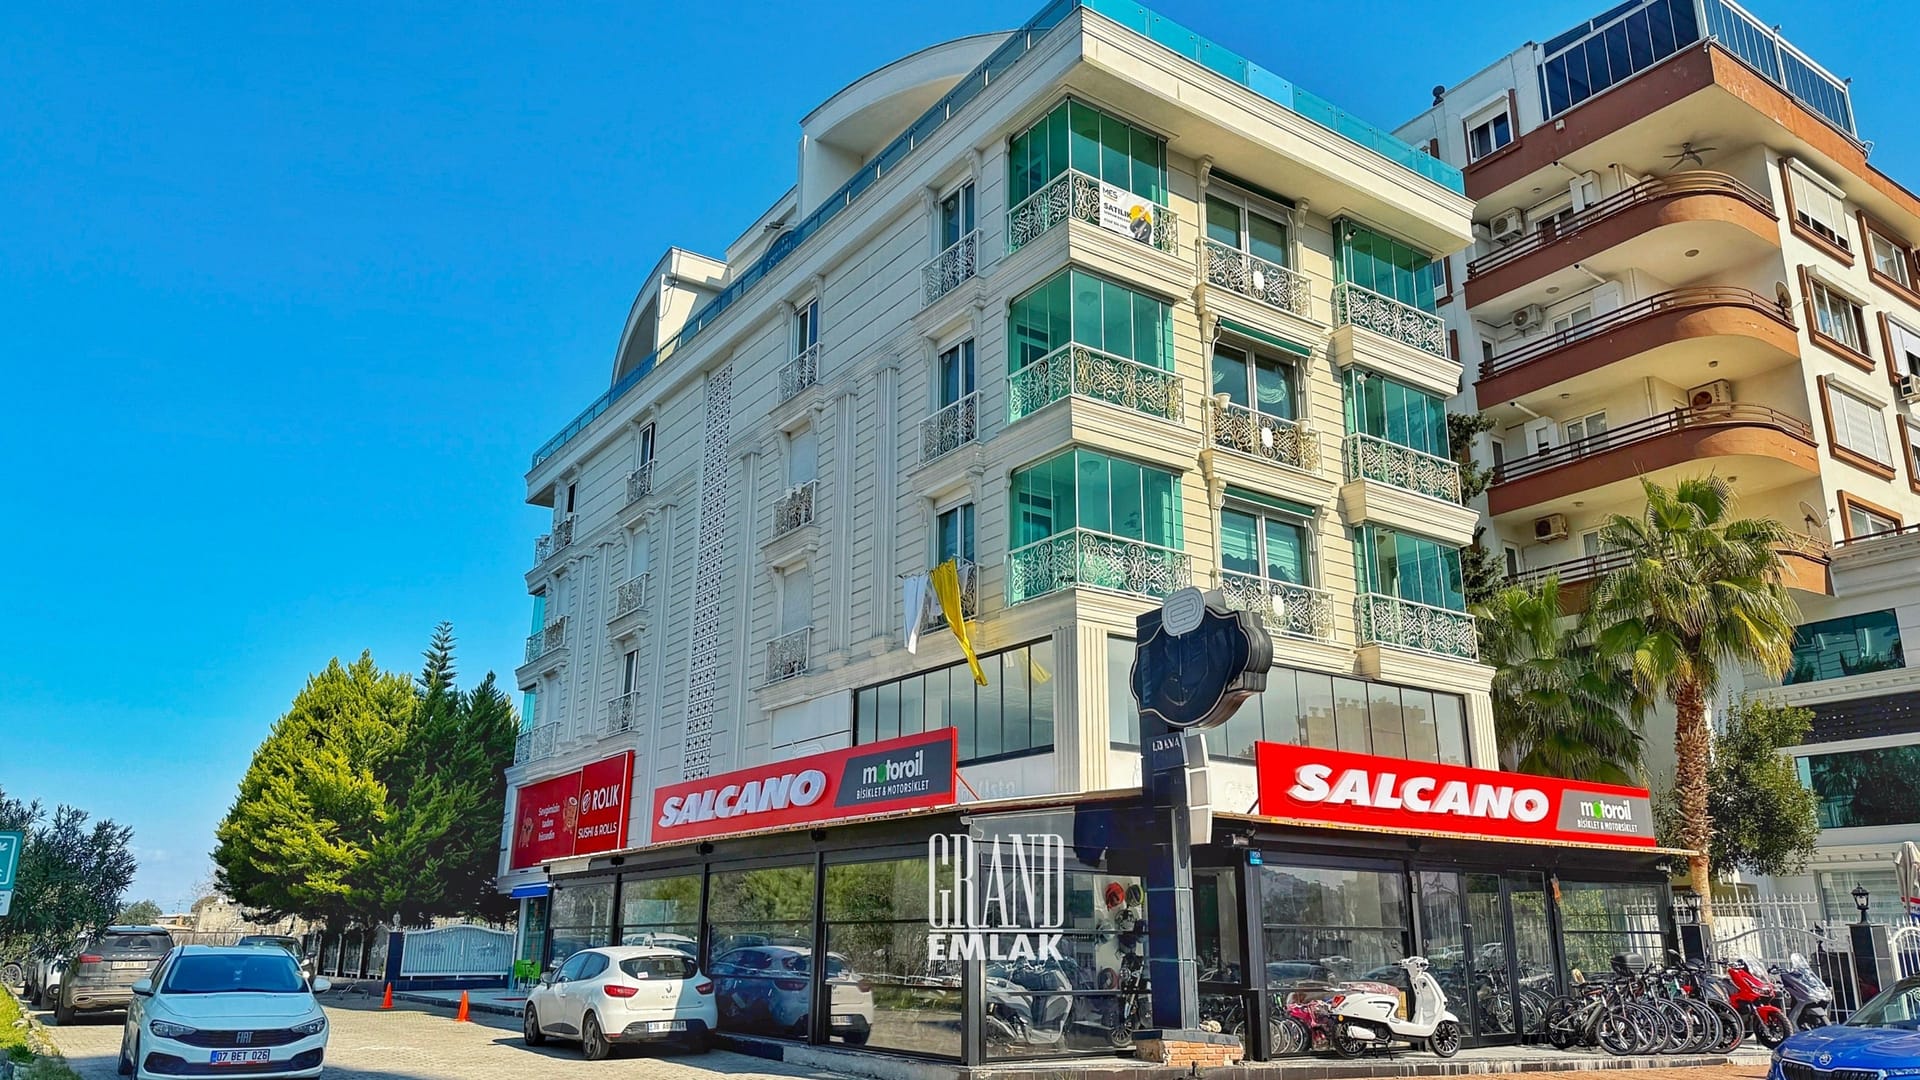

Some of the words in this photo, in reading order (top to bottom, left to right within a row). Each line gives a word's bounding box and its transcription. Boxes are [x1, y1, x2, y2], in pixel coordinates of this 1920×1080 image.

[1103, 202, 1132, 219] SATILIK
[863, 750, 924, 784] motoroil
[592, 784, 620, 811] ROLIK
[658, 769, 826, 828] SALCANO
[856, 786, 882, 800] BİSİKLET
[887, 780, 929, 794] MOTORSİKLET
[1287, 764, 1549, 823] SALCANO
[1580, 800, 1632, 820] motoroil
[578, 825, 594, 839] SUSHI
[599, 822, 617, 835] ROLLS
[236, 1032, 253, 1043] FIAT
[217, 1052, 228, 1062] 07
[231, 1051, 248, 1062] BET
[252, 1050, 268, 1061] 026
